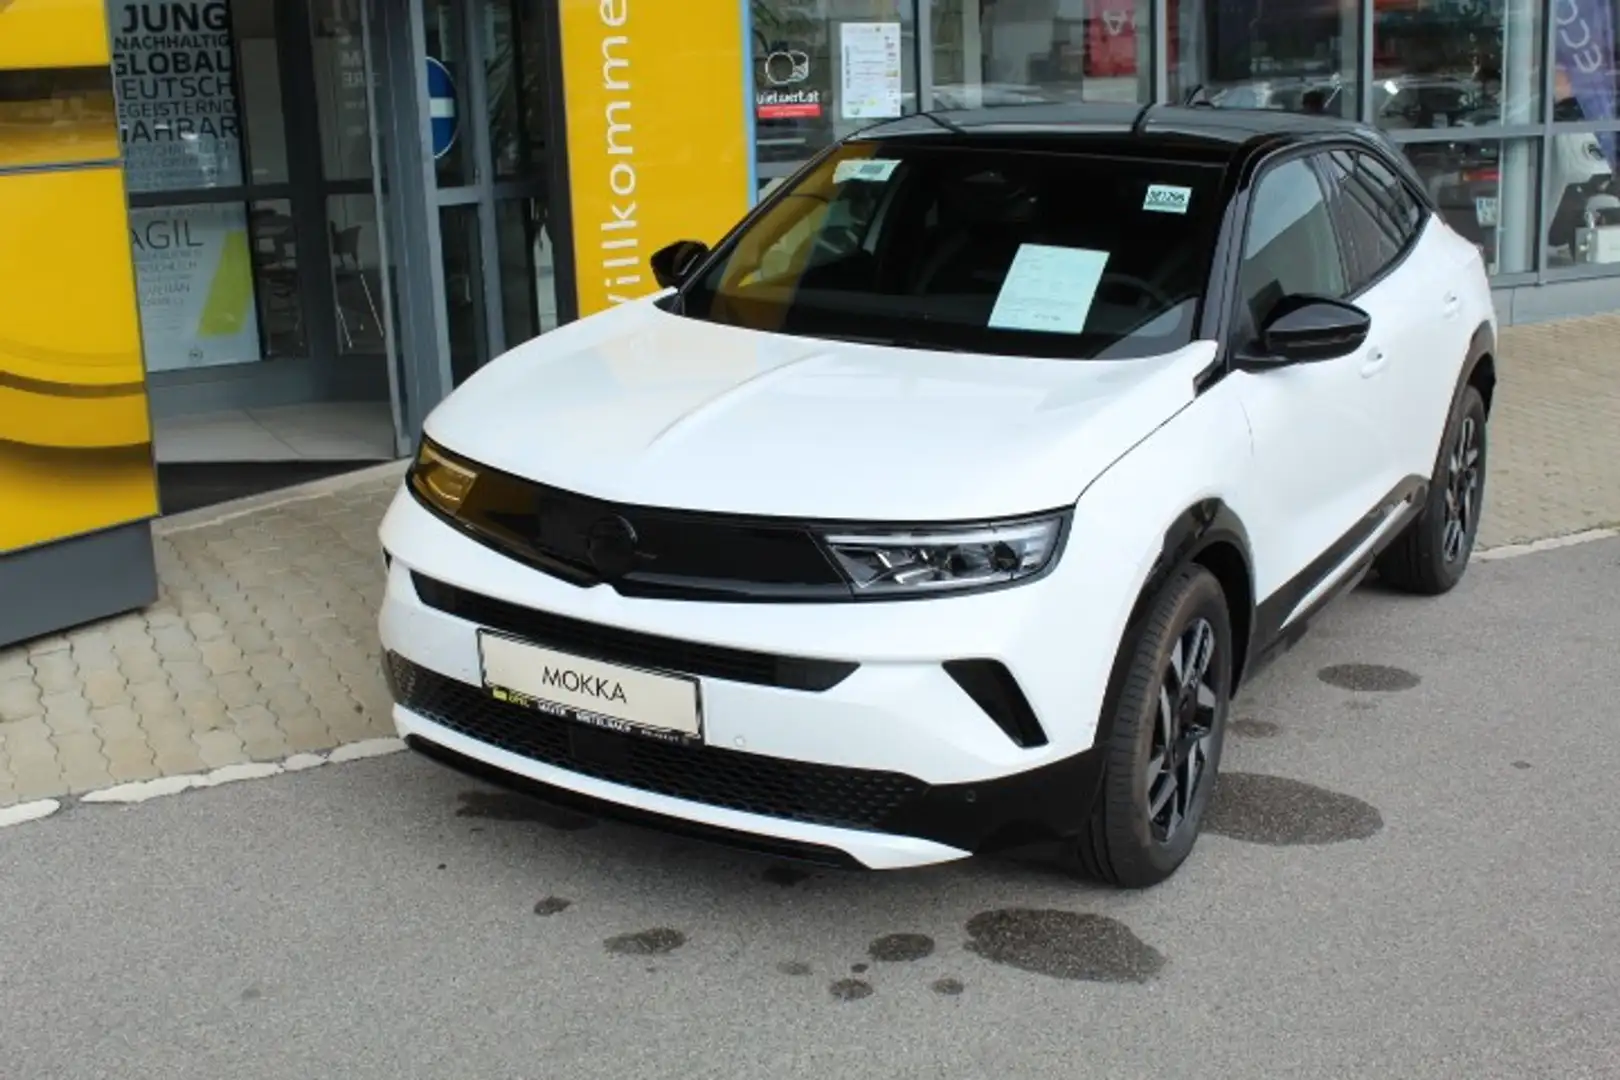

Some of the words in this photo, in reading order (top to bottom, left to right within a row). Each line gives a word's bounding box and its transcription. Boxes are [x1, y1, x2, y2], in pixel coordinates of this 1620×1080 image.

[121, 2, 227, 33] JUNG
[114, 33, 229, 50] NACHHALTIG
[117, 76, 233, 100] EUTSCH
[599, 0, 642, 303] illkomme
[541, 665, 628, 704] MOKKA
